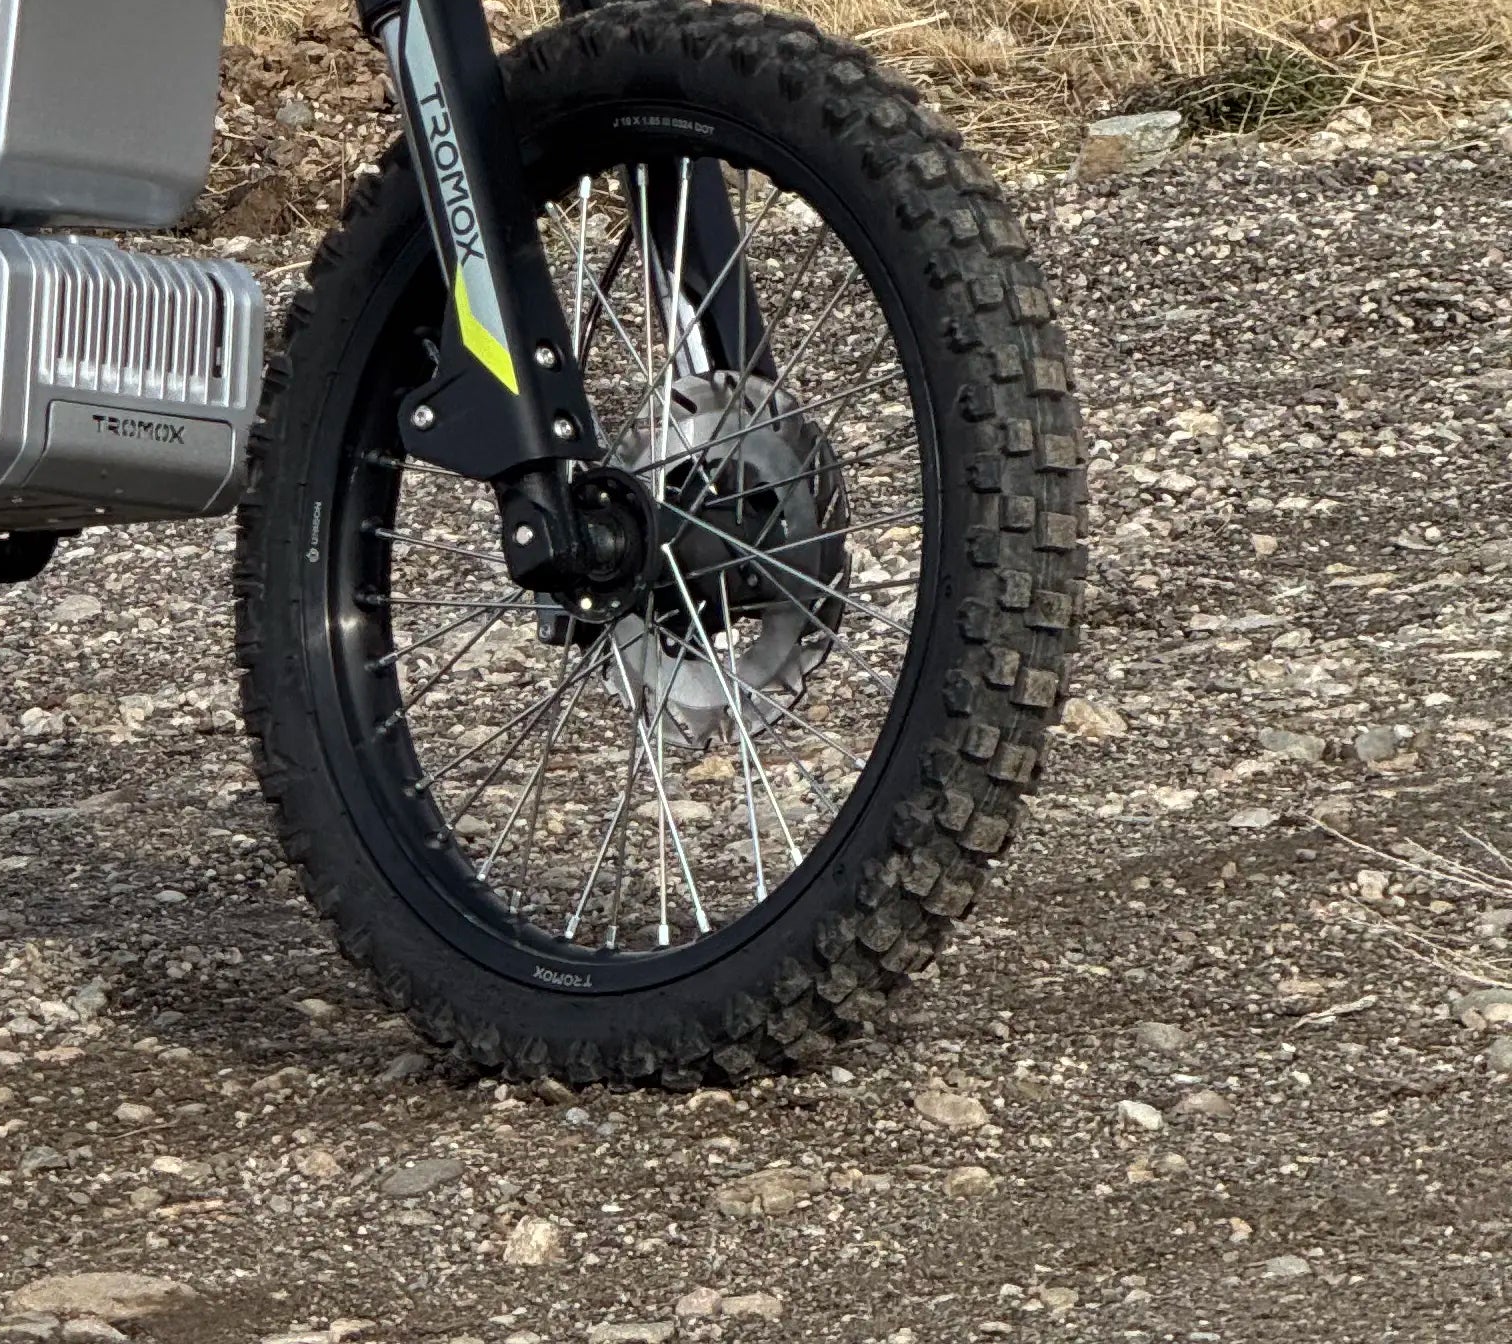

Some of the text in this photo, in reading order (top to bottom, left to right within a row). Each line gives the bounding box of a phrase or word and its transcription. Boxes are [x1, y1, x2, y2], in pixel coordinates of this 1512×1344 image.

[421, 81, 485, 266] TROMOX
[92, 414, 186, 445] TROMOX
[533, 965, 593, 988] TROMOX
